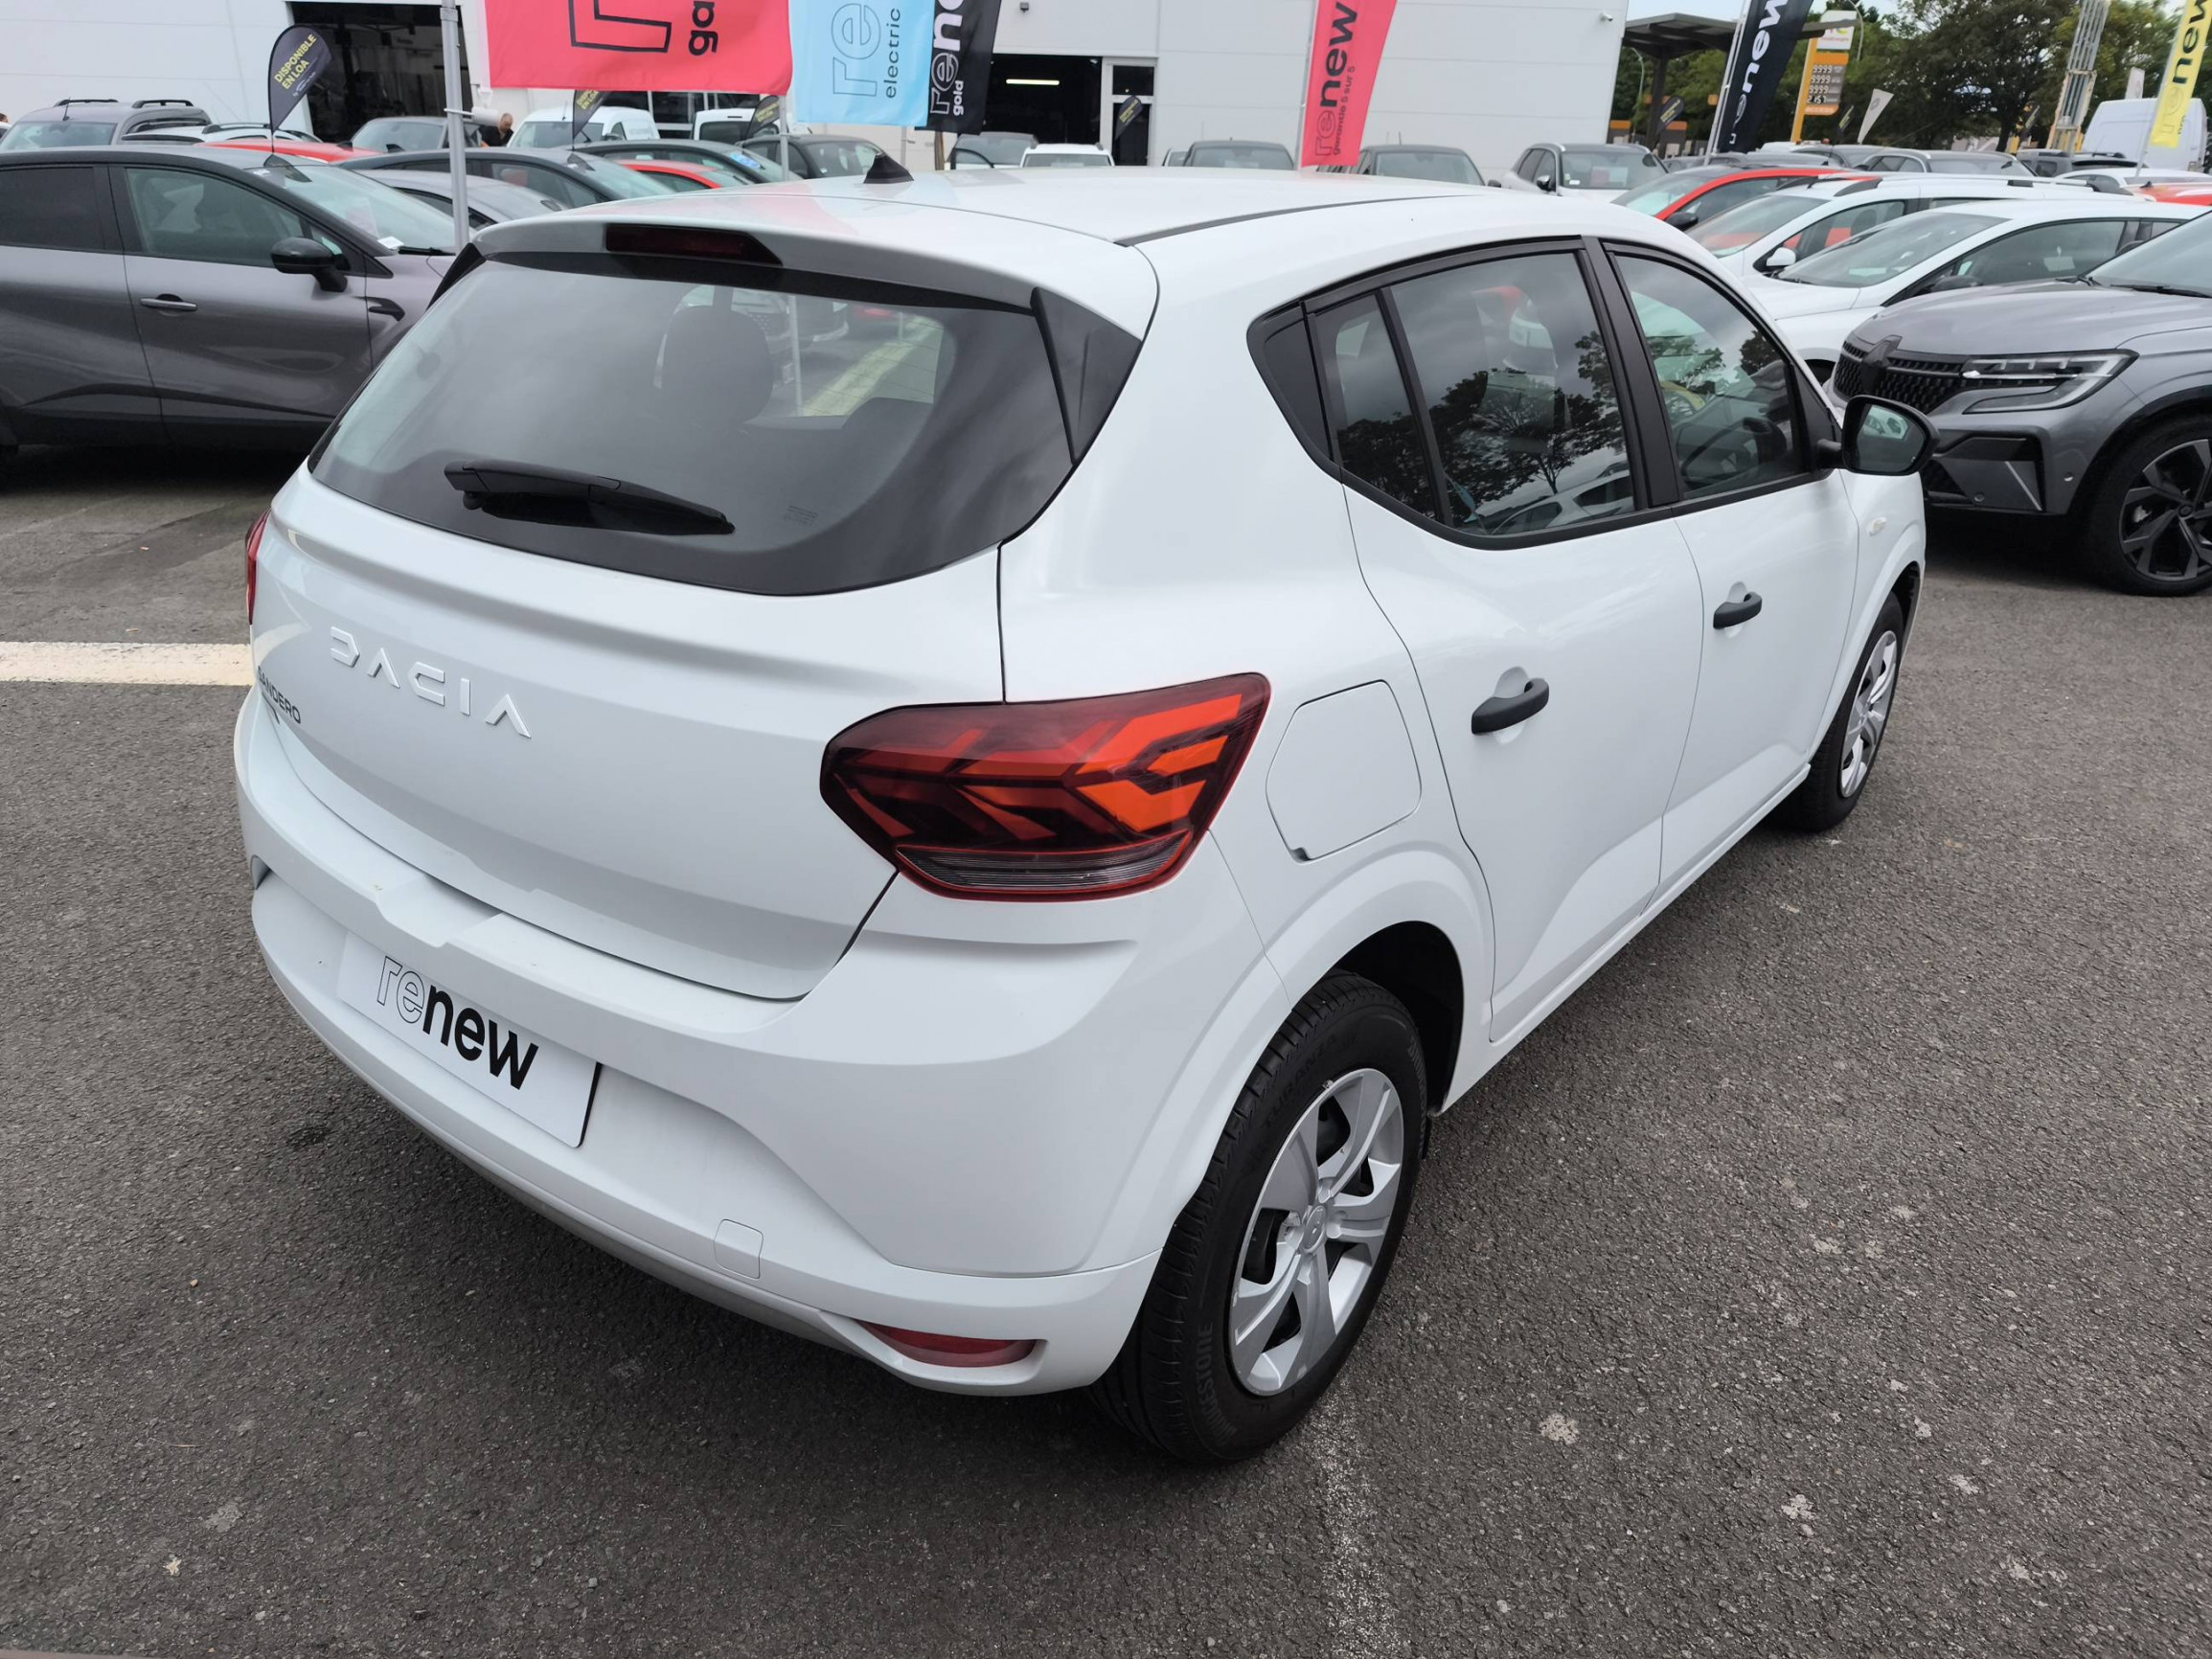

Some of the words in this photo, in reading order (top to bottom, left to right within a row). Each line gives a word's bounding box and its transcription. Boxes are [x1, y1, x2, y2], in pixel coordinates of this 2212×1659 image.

[274, 34, 317, 83] DISPONIBLE
[282, 74, 295, 89] EN
[293, 59, 309, 78] LOA
[883, 8, 901, 99] electric
[930, 0, 964, 115] ren
[1315, 2, 1358, 156] renew
[952, 80, 964, 116] gold
[1334, 106, 1346, 155] garantie
[1343, 76, 1354, 94] sur
[257, 665, 302, 725] SANDERO
[330, 625, 532, 739] DACIA
[376, 955, 538, 1090] renew
